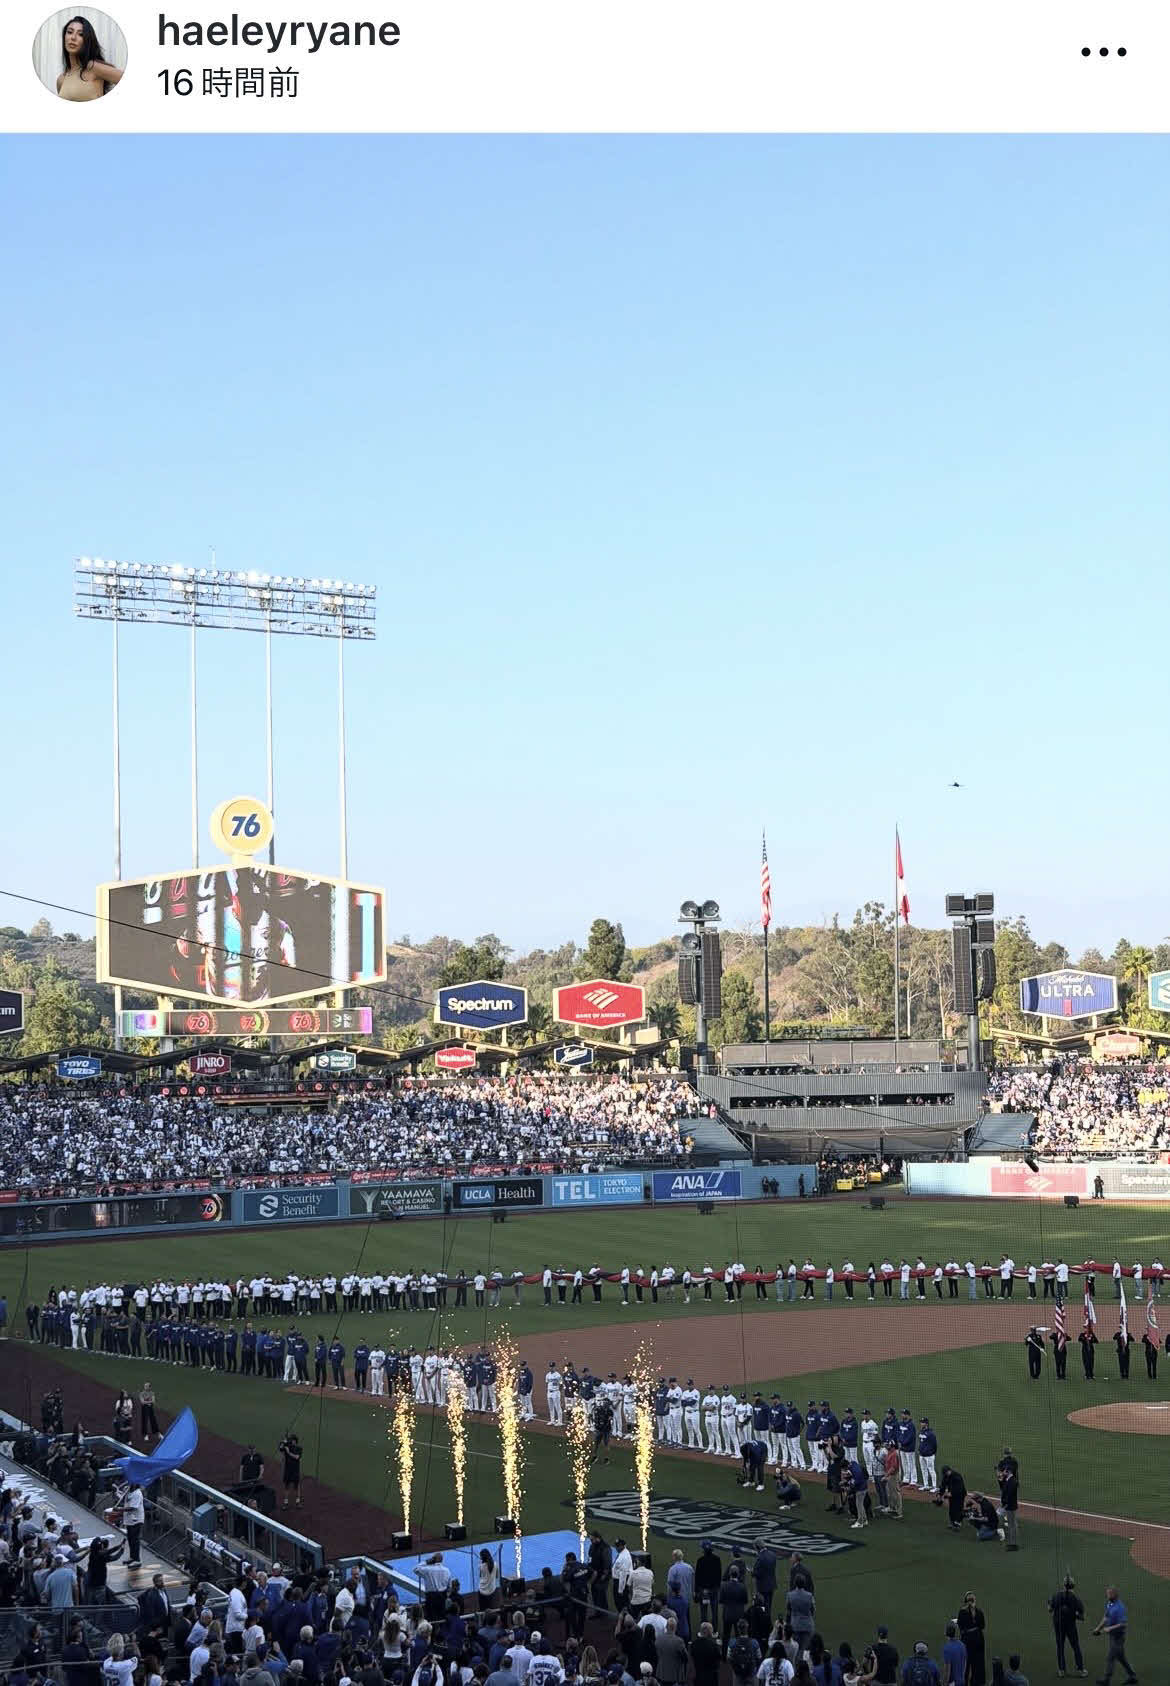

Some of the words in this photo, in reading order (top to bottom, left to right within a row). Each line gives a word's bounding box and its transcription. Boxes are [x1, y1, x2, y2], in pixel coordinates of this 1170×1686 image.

[232, 813, 261, 838] 76
[1041, 984, 1095, 998] ULTRA
[447, 997, 513, 1014] Spectrum
[190, 1017, 207, 1028] 76
[294, 1016, 309, 1026] 76
[63, 1060, 90, 1068] TOYO
[196, 1057, 225, 1071] JINRO
[67, 1067, 96, 1075] TIRES
[603, 1178, 627, 1187] TOKYO
[671, 1175, 705, 1190] ANA
[465, 1189, 491, 1200] UCLA
[498, 1186, 536, 1200] Health
[555, 1180, 596, 1200] TEL
[603, 1185, 641, 1195] ELECTRON
[282, 1193, 322, 1207] Security
[412, 1197, 436, 1205] CASINO
[283, 1203, 317, 1216] Benefit
